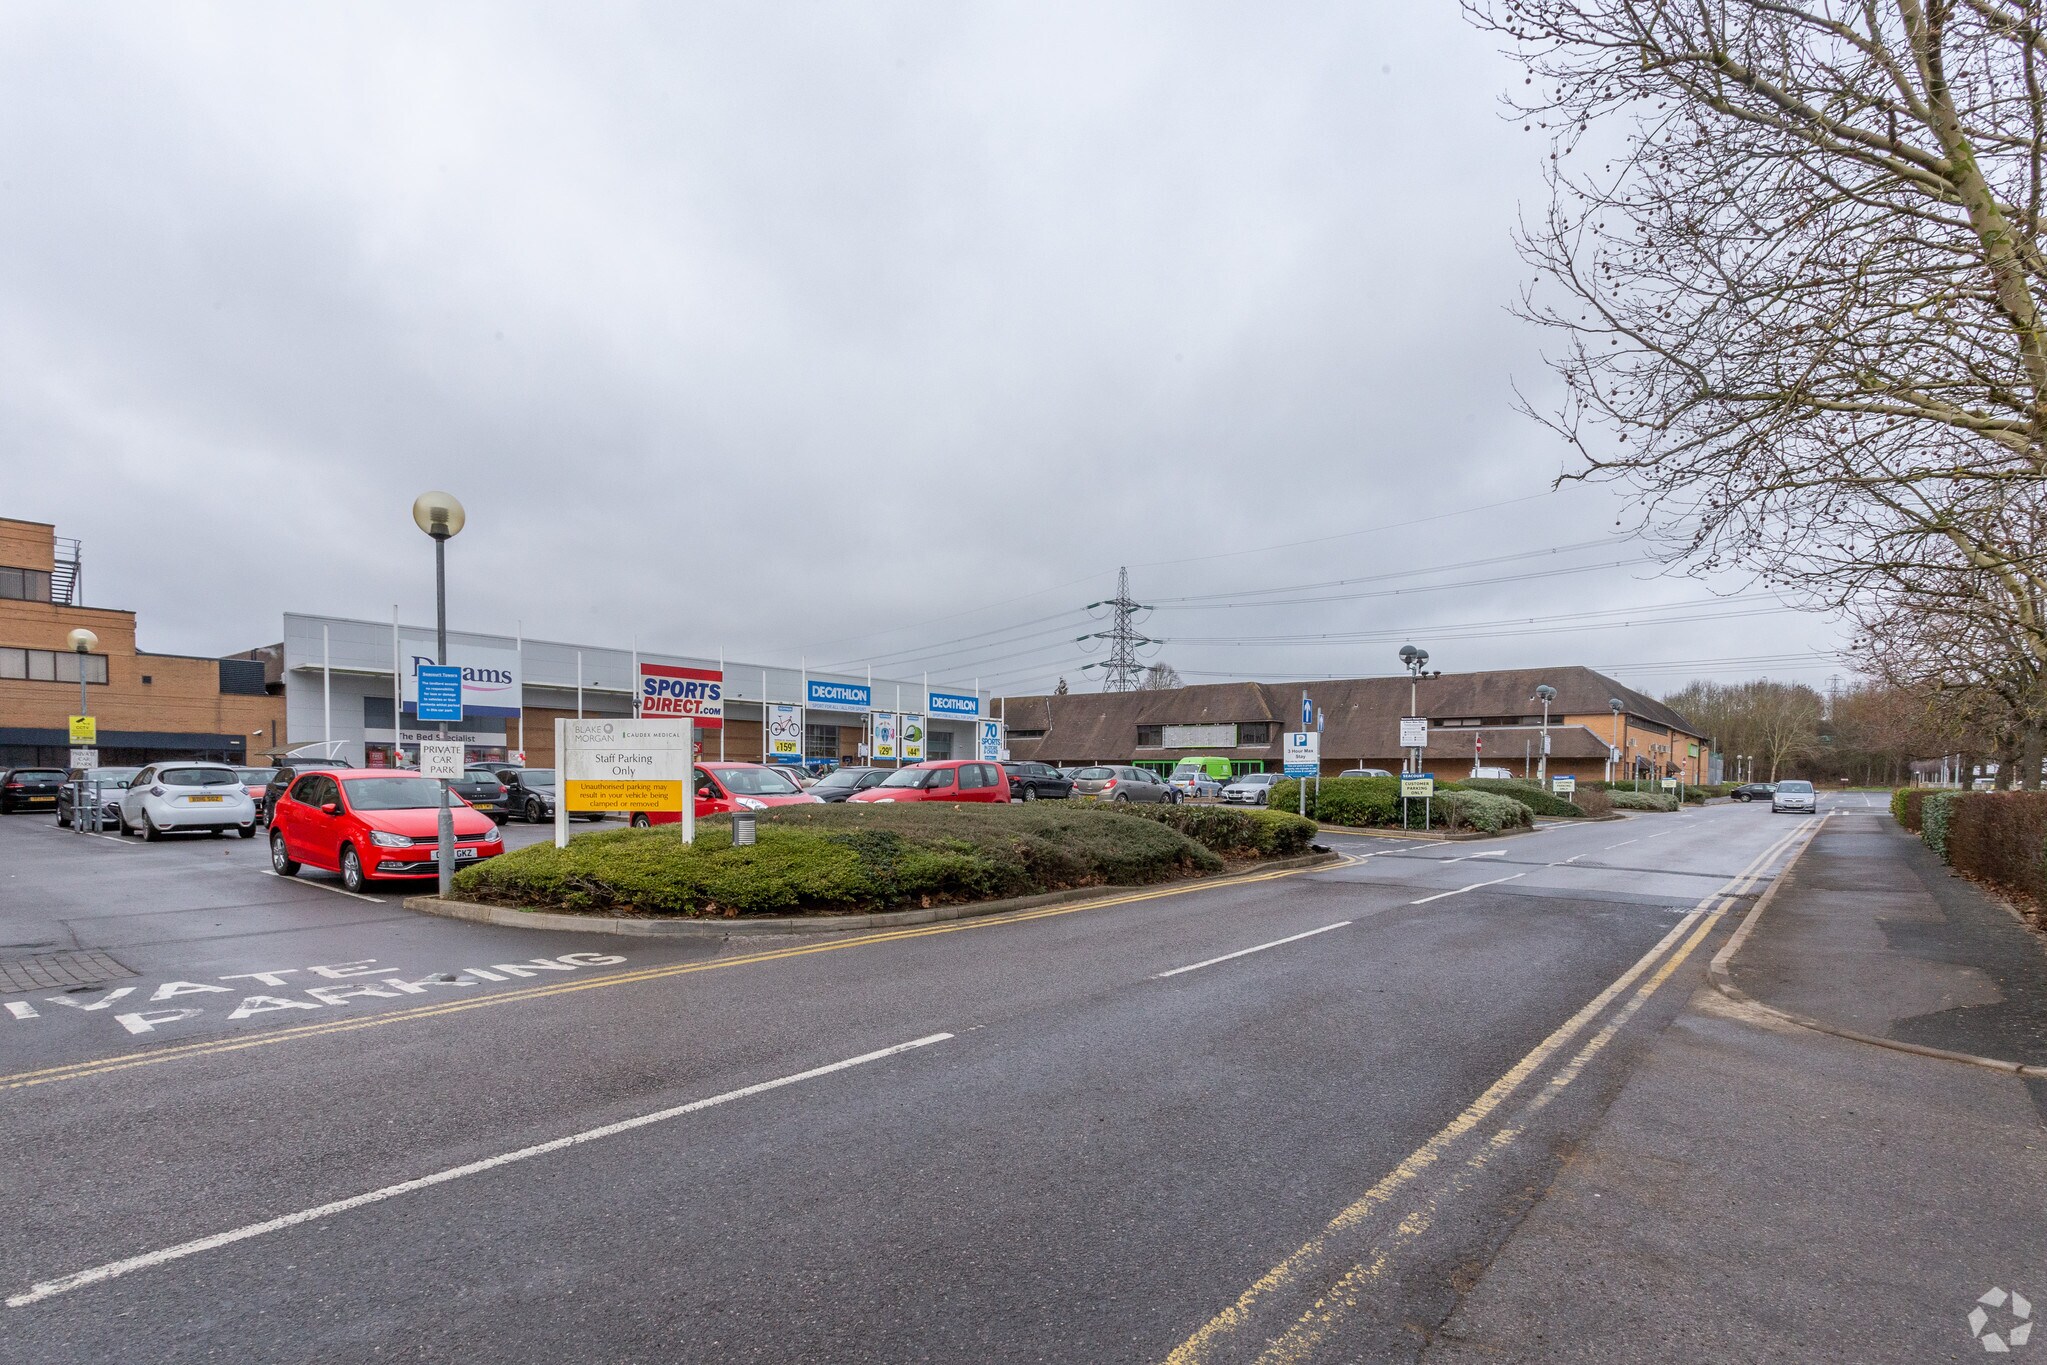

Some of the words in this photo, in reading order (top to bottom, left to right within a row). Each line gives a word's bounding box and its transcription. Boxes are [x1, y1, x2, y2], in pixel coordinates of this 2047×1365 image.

[411, 656, 512, 684] Dams
[643, 678, 721, 700] SPORTS
[812, 685, 867, 701] DECATHLON
[932, 697, 975, 711] DECATHLON
[985, 723, 997, 738] 70
[436, 734, 476, 742] Secialist
[423, 746, 461, 754] PRIVATE
[595, 754, 614, 763] Staff
[618, 754, 652, 765] Parking
[612, 766, 636, 777] Only
[114, 952, 628, 1034] PARKING
